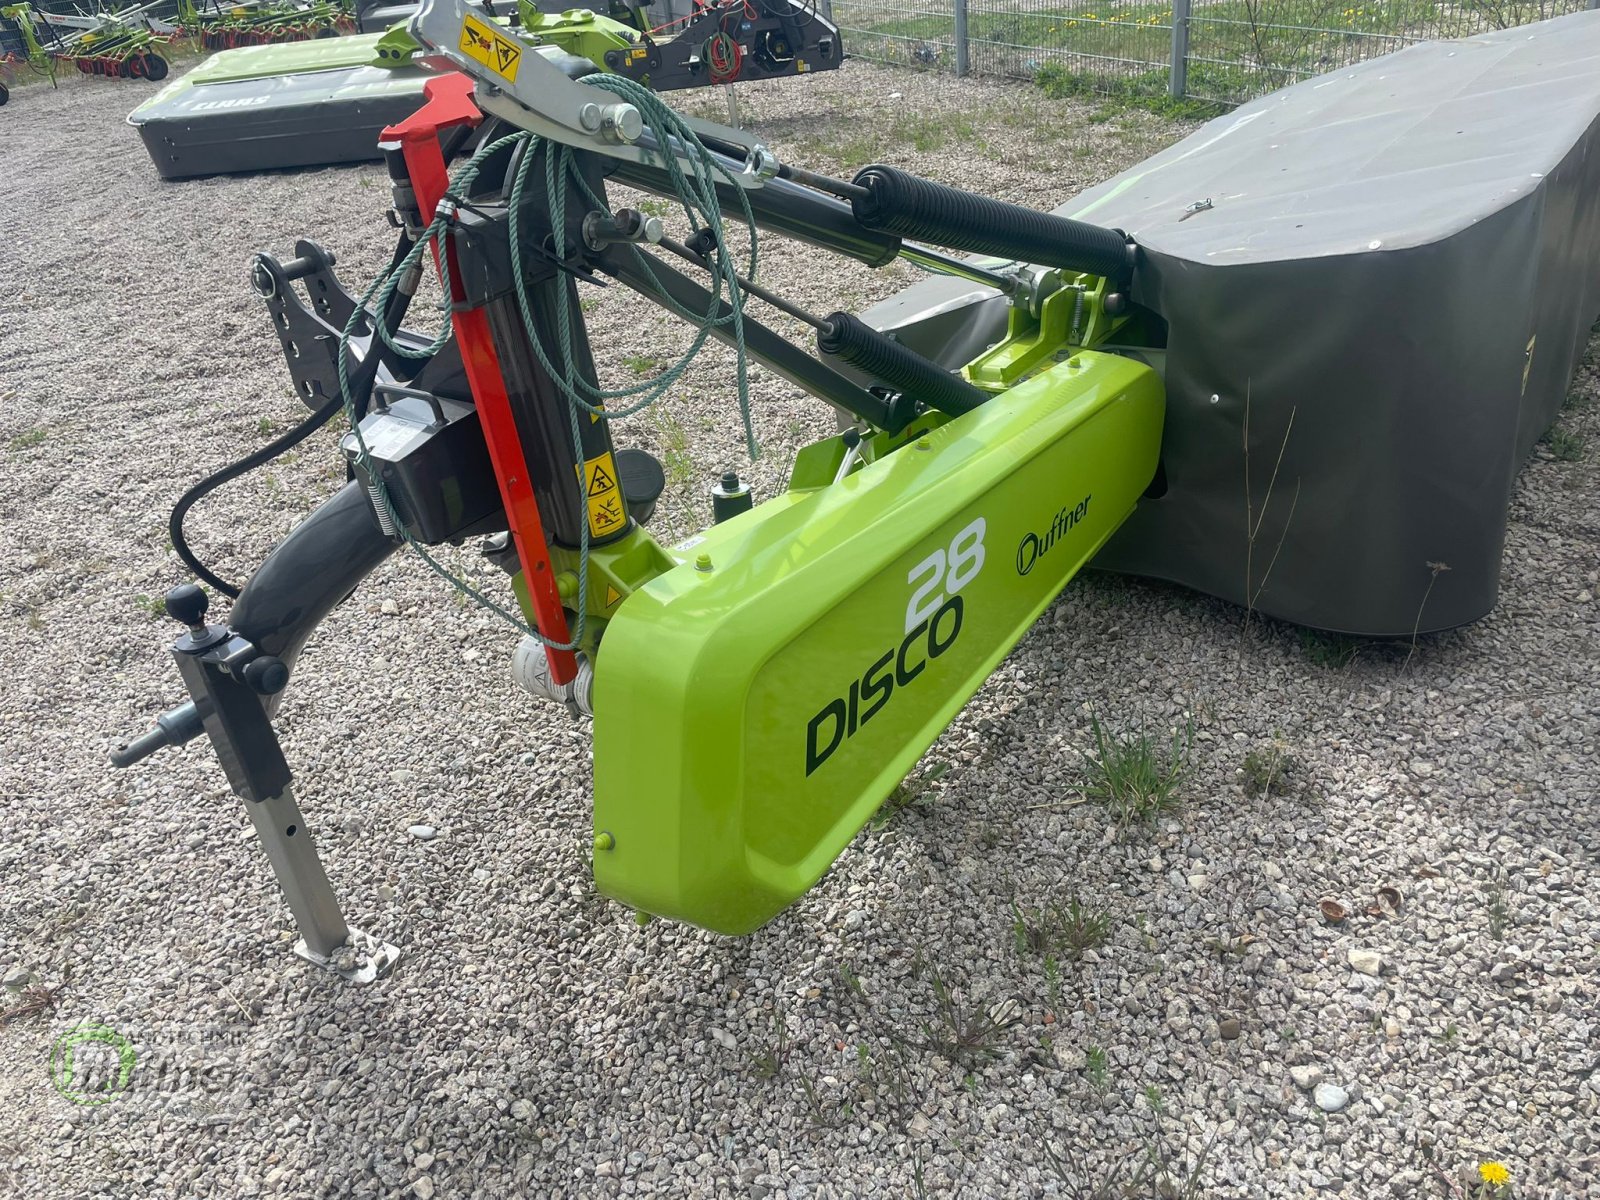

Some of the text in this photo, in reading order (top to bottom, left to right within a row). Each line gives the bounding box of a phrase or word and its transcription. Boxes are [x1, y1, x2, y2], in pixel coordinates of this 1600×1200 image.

[904, 516, 987, 636] 28
[1016, 493, 1092, 576] Duffner
[805, 595, 964, 778] DISCO
